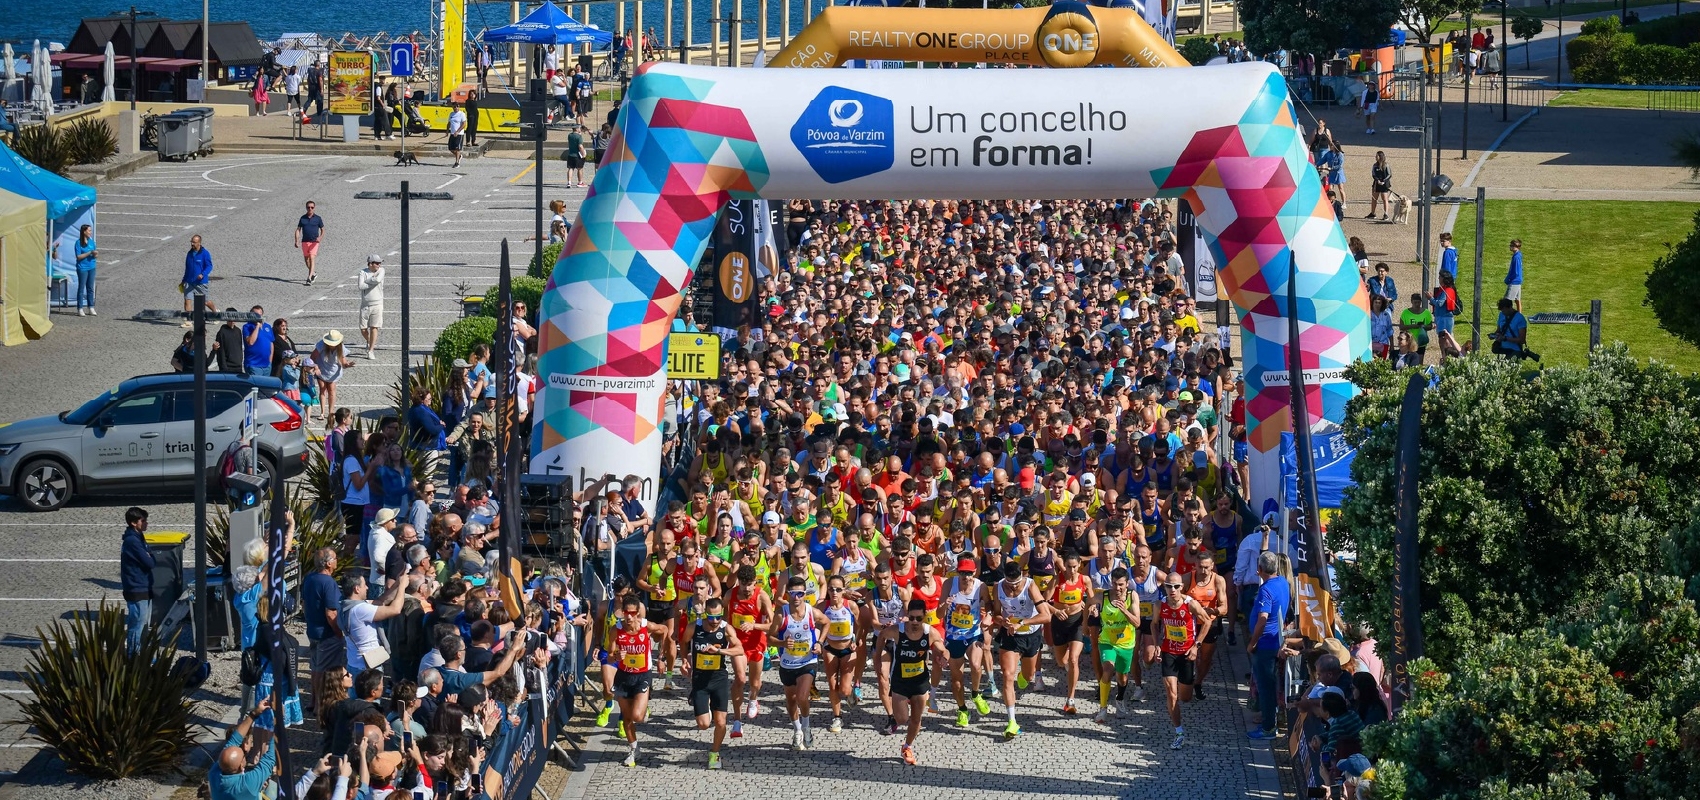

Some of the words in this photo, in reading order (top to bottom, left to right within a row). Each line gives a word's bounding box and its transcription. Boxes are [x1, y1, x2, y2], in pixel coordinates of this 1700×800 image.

[1043, 33, 1096, 51] ONE
[785, 44, 816, 68] ÇÃO
[985, 51, 1029, 61] PLACE
[336, 61, 365, 69] TURBO
[336, 68, 365, 76] BACON
[910, 105, 966, 133] Um
[980, 102, 1127, 133] concelho
[807, 128, 840, 141] Póvoa
[848, 128, 885, 141] Varzim
[910, 147, 958, 167] em
[972, 135, 1092, 167] forma!
[732, 257, 744, 300] ONE
[666, 353, 705, 374] ELITE
[550, 375, 655, 391] www.cm-pvarzim.pt
[165, 441, 214, 454] triauo
